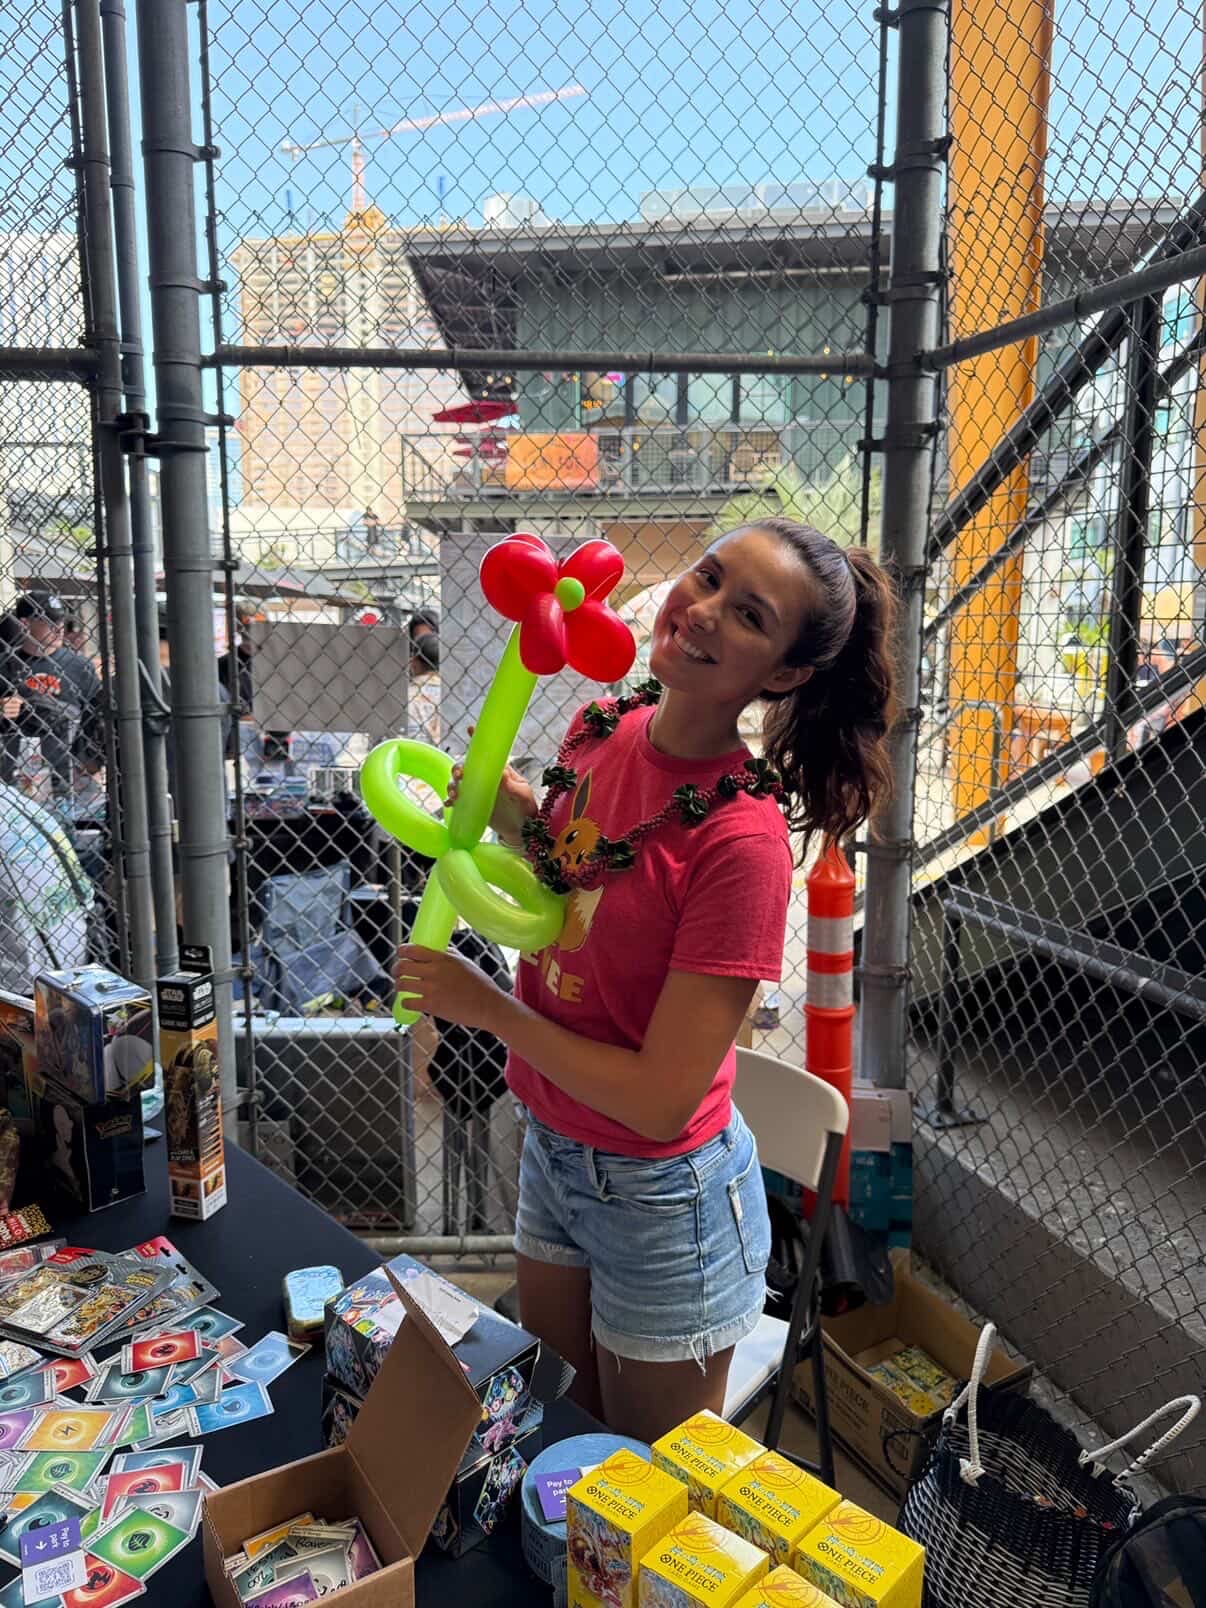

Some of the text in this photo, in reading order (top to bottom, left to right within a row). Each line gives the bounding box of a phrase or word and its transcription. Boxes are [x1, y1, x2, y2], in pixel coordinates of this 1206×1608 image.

[546, 1480, 562, 1489] Pay
[552, 1487, 568, 1497] par
[586, 1485, 638, 1521] ONE PIECE
[739, 1486, 794, 1528] ONE PIECE
[660, 1553, 720, 1593] ONE PIECE
[817, 1542, 879, 1585] ONE PIECE
